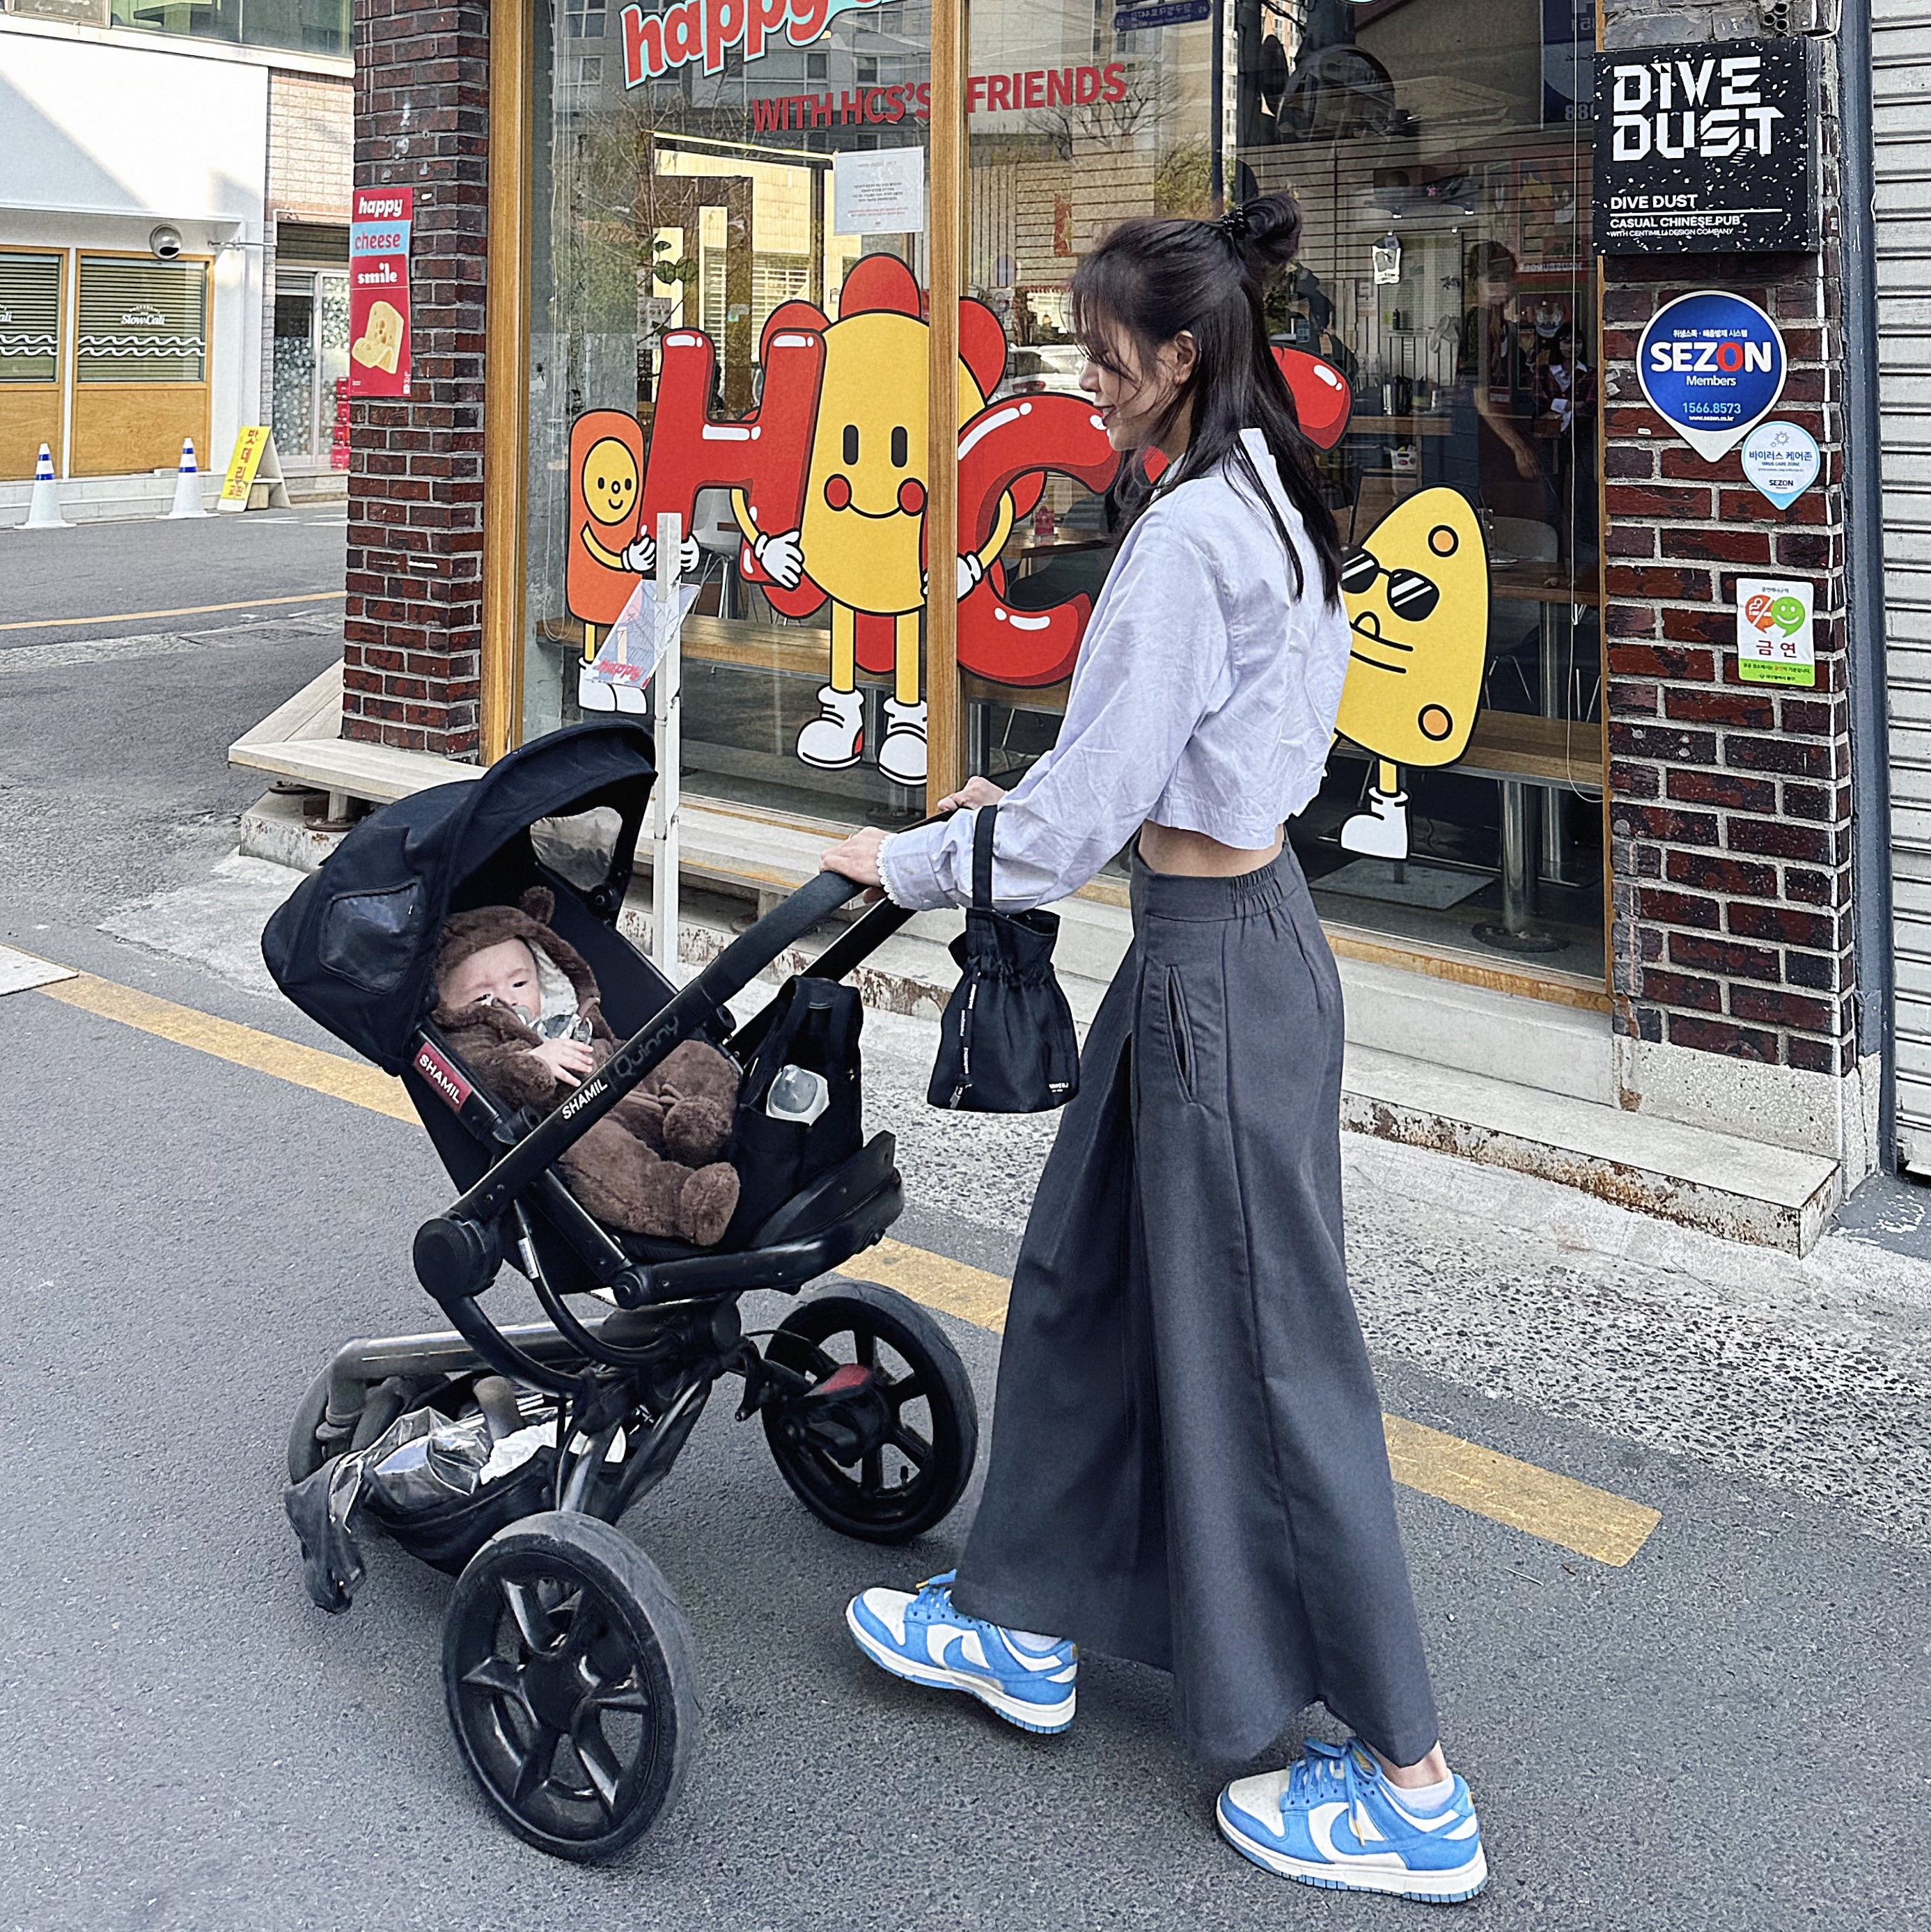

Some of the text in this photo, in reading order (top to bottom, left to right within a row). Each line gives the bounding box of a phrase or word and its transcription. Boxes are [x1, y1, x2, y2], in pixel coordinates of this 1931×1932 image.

[1613, 56, 1761, 112] DIVE
[752, 91, 832, 132] WITH
[967, 63, 1127, 113] FRIENDS
[1613, 106, 1785, 161] DUST
[358, 196, 403, 218] happy
[1610, 194, 1698, 210] DIVE DUST
[1610, 216, 1740, 228] CASUAL CHINESE PUB
[354, 232, 401, 249] cheese
[357, 262, 398, 284] smile
[1729, 329, 1748, 338] 시스템
[1650, 341, 1772, 372] SEZON
[1686, 375, 1737, 387] Members
[1682, 402, 1742, 414] 1566.8573
[1749, 450, 1813, 461] 바이러스 케어존
[614, 1014, 680, 1078] Quinny
[418, 1053, 461, 1106] SHAMIL
[562, 1078, 609, 1121] SHAMIL
